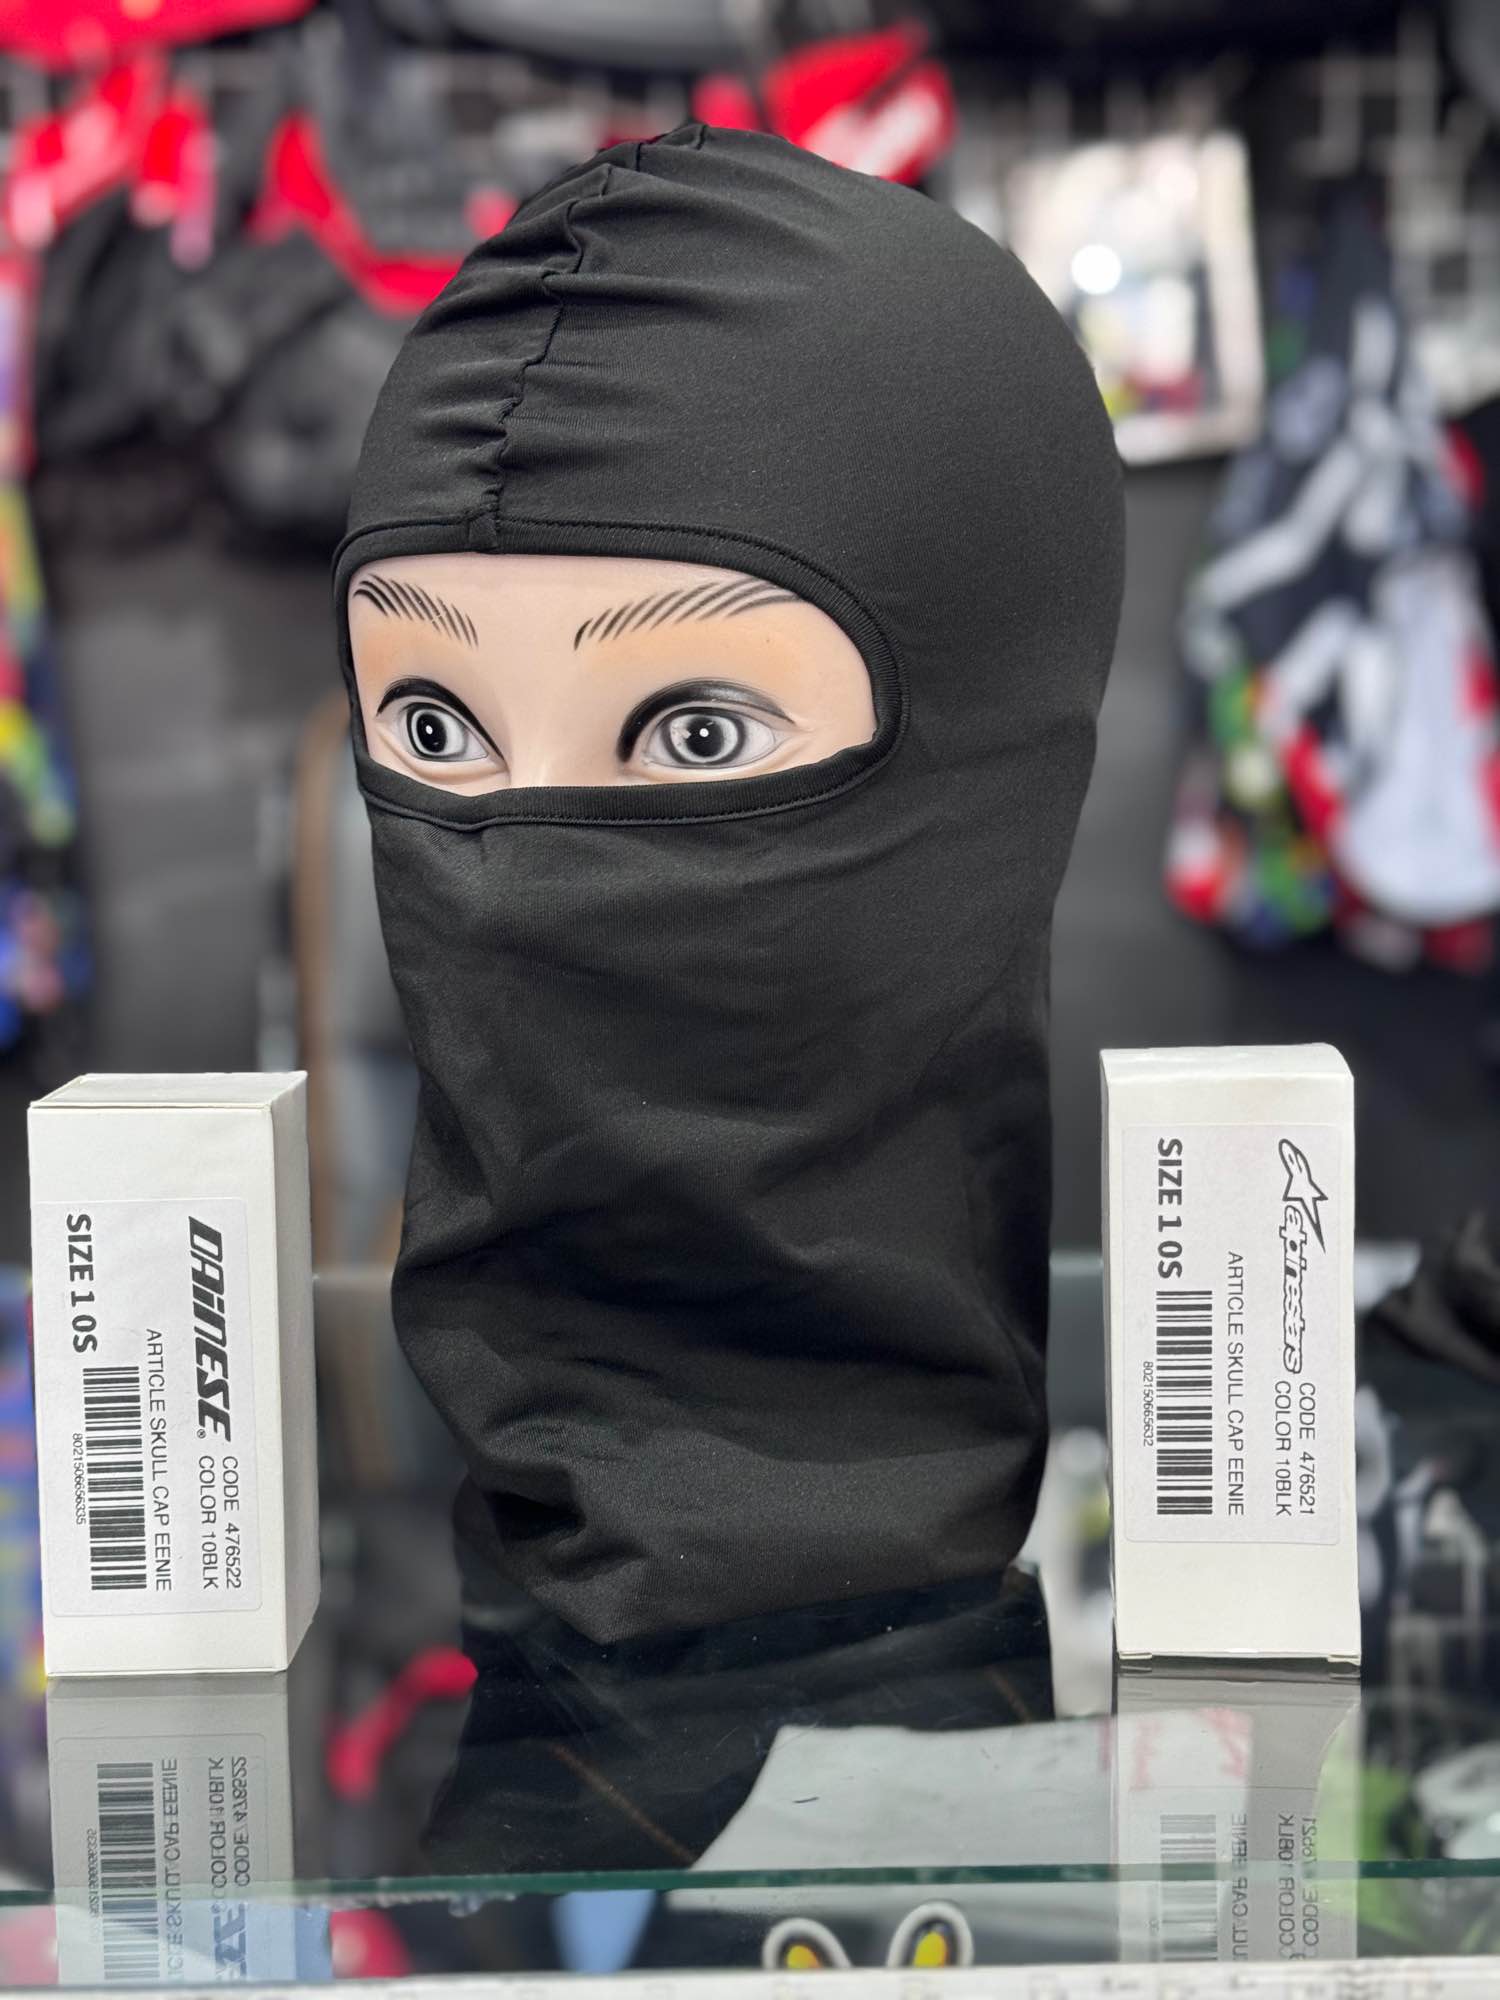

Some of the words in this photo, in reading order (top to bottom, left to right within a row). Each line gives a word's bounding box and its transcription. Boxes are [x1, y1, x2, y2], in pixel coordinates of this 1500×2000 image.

[1158, 1138, 1182, 1205] SIZE
[67, 1214, 93, 1282] SIZE
[1158, 1215, 1182, 1232] 1
[71, 1291, 94, 1307] 1
[1228, 1252, 1244, 1336] ARTICLE
[1280, 1205, 1309, 1375] alpinestars
[147, 1329, 165, 1411] ARTICLE
[1228, 1342, 1243, 1404] SKULL
[1228, 1410, 1244, 1451] CAP
[1275, 1381, 1291, 1451] COLOR
[1299, 1383, 1315, 1439] CODE
[150, 1418, 167, 1481] SKULL
[153, 1486, 169, 1525] CAP
[199, 1456, 216, 1524] COLOR
[223, 1456, 239, 1511] CODE
[1229, 1458, 1243, 1515] EENIE
[1276, 1459, 1291, 1515] 10BLK
[1300, 1452, 1315, 1514] 476521
[155, 1533, 171, 1590] EENIE
[202, 1532, 218, 1589] 10BLK
[225, 1523, 241, 1588] 476522
